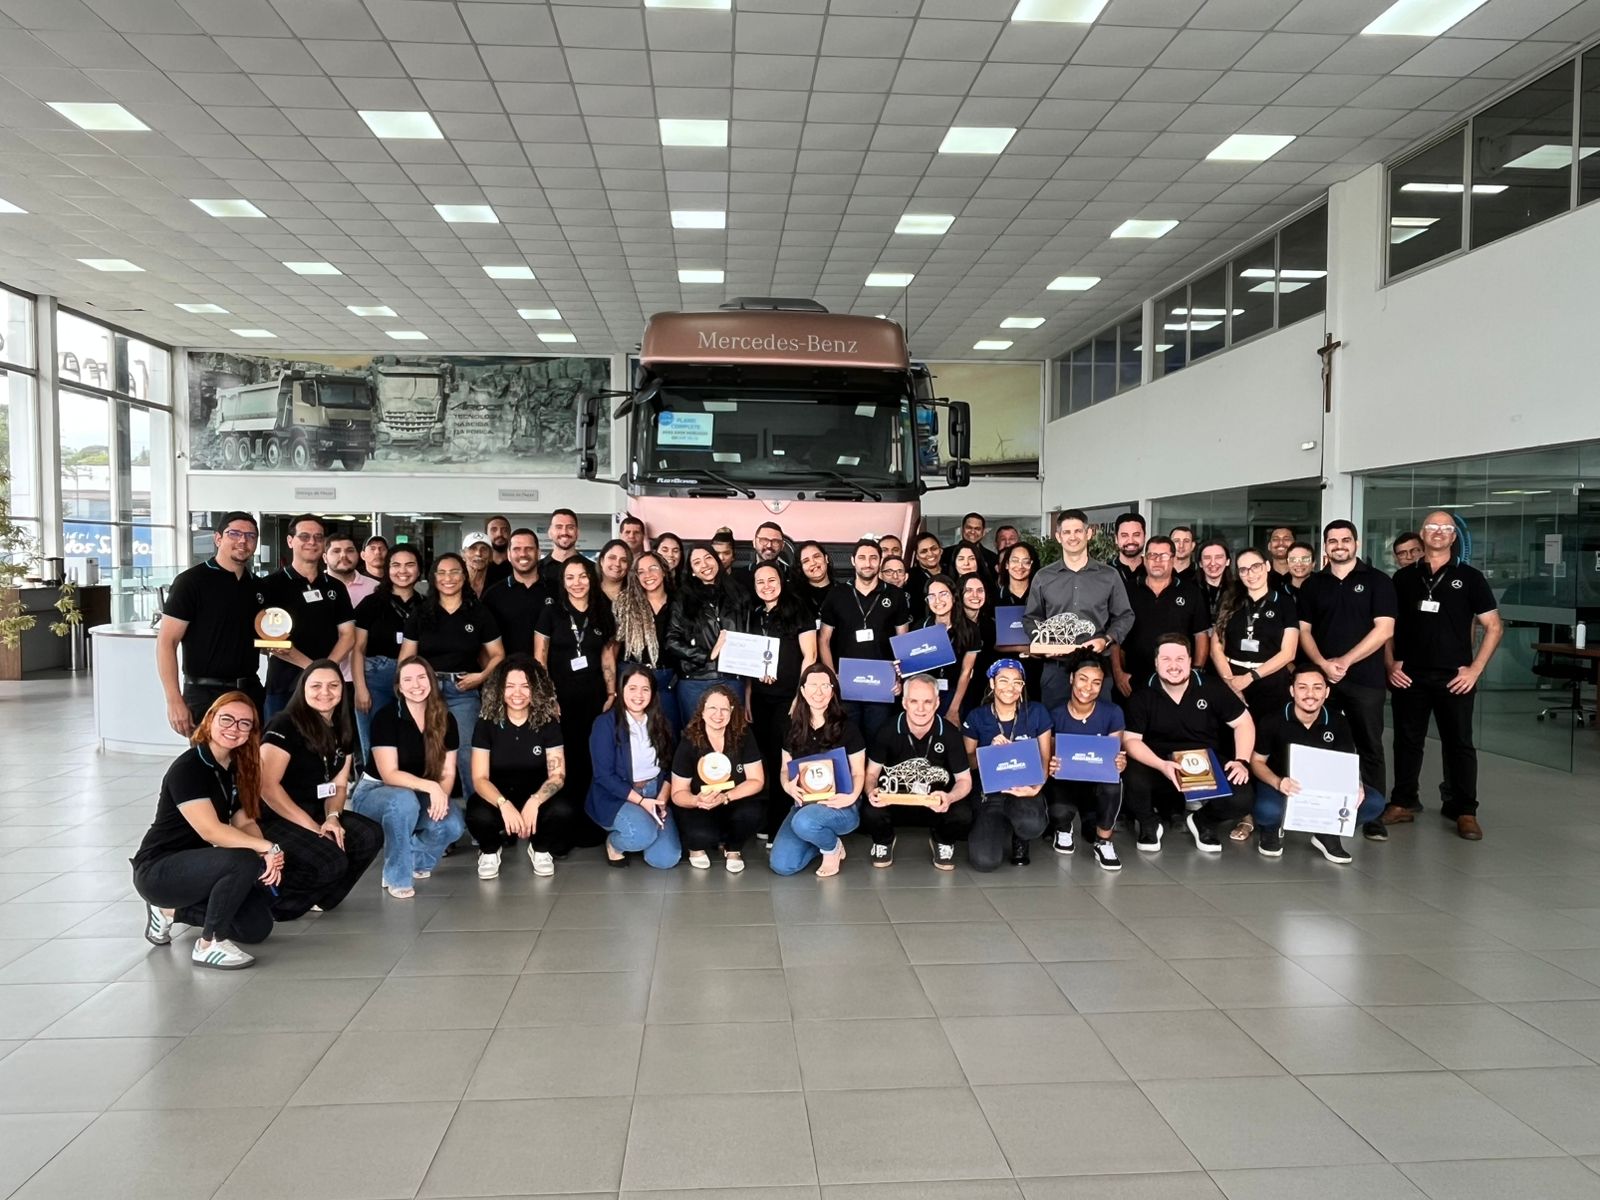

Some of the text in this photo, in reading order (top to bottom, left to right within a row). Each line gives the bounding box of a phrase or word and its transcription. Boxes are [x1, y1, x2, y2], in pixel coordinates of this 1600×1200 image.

[698, 331, 858, 353] Mercedes-Benz
[1031, 629, 1050, 646] 20
[1185, 757, 1200, 767] 10
[810, 767, 824, 779] 15
[879, 775, 899, 794] 30
